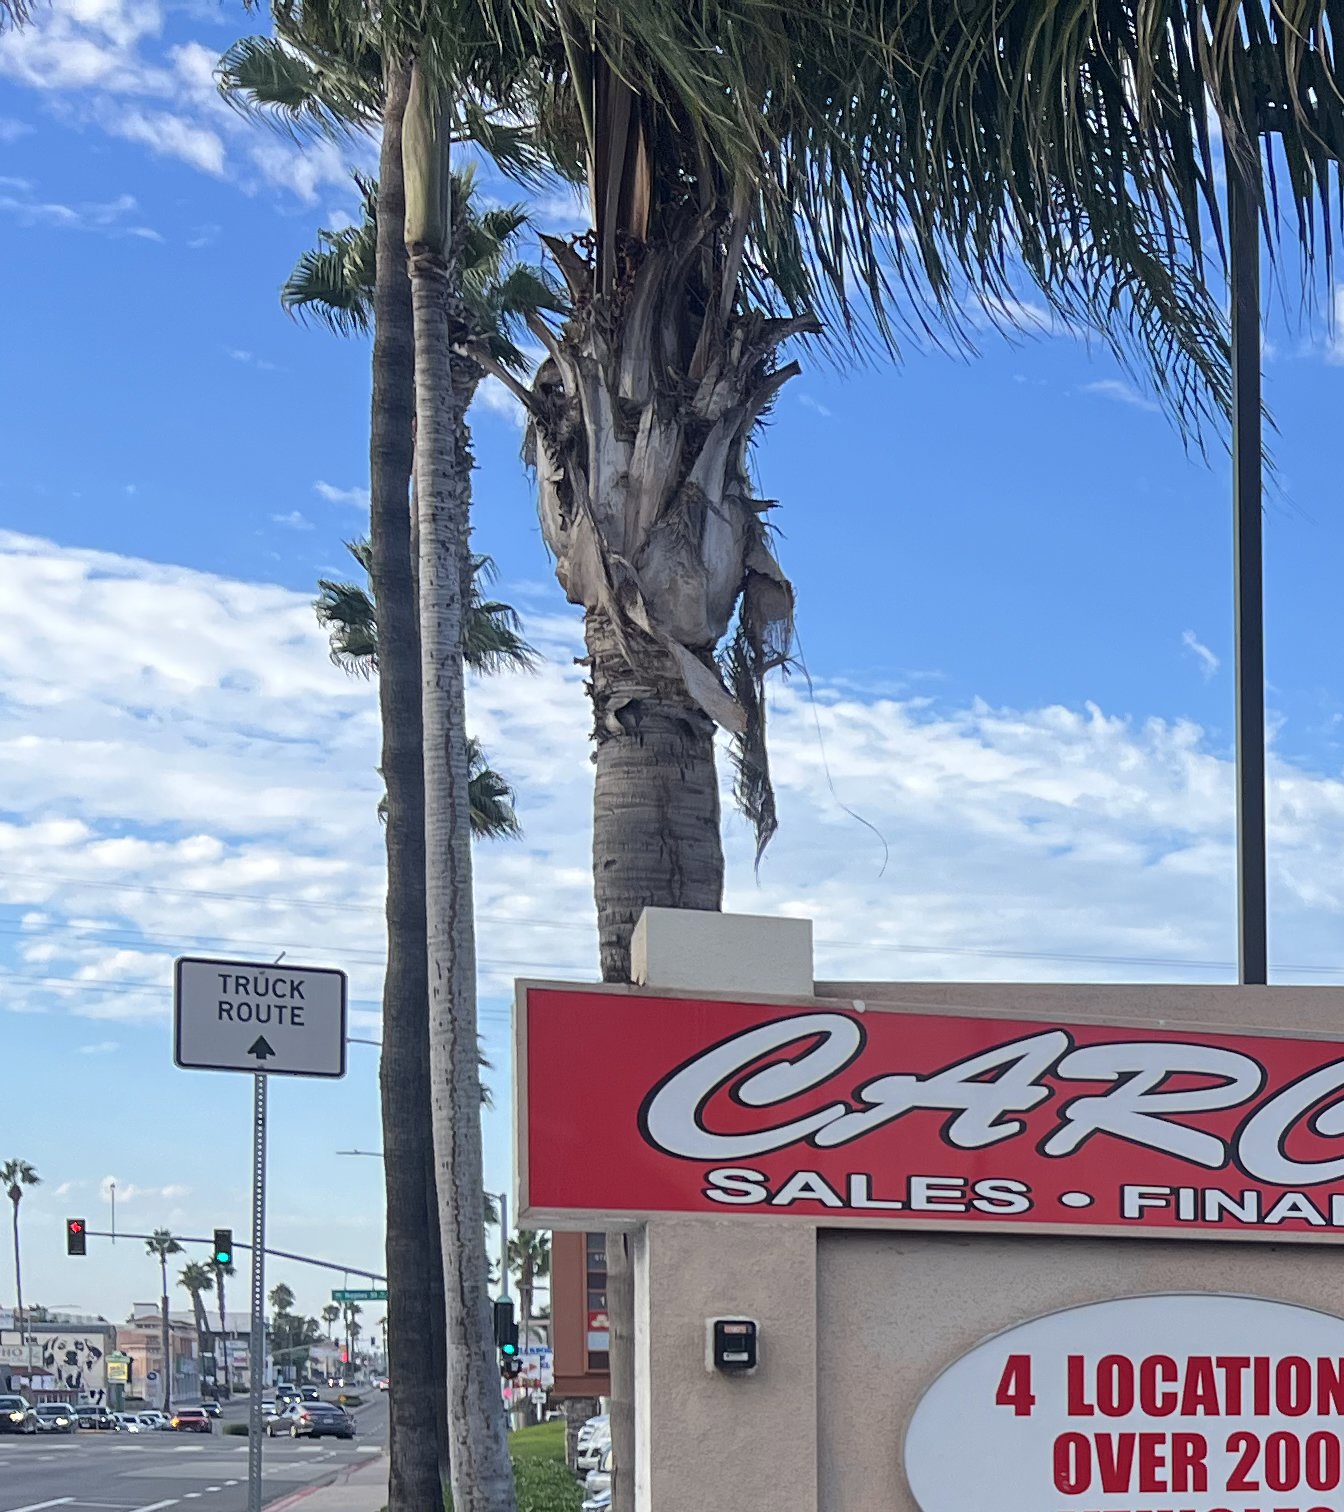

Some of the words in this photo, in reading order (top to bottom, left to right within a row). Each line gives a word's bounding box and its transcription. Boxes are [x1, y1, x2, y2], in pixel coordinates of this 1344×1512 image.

[217, 973, 305, 1000] TRUCK
[217, 1000, 305, 1027] ROUTE
[703, 1167, 1033, 1216] SALES
[995, 1354, 1036, 1417] 4
[1053, 1431, 1208, 1495] OVER
[1225, 1430, 1341, 1492] 200
